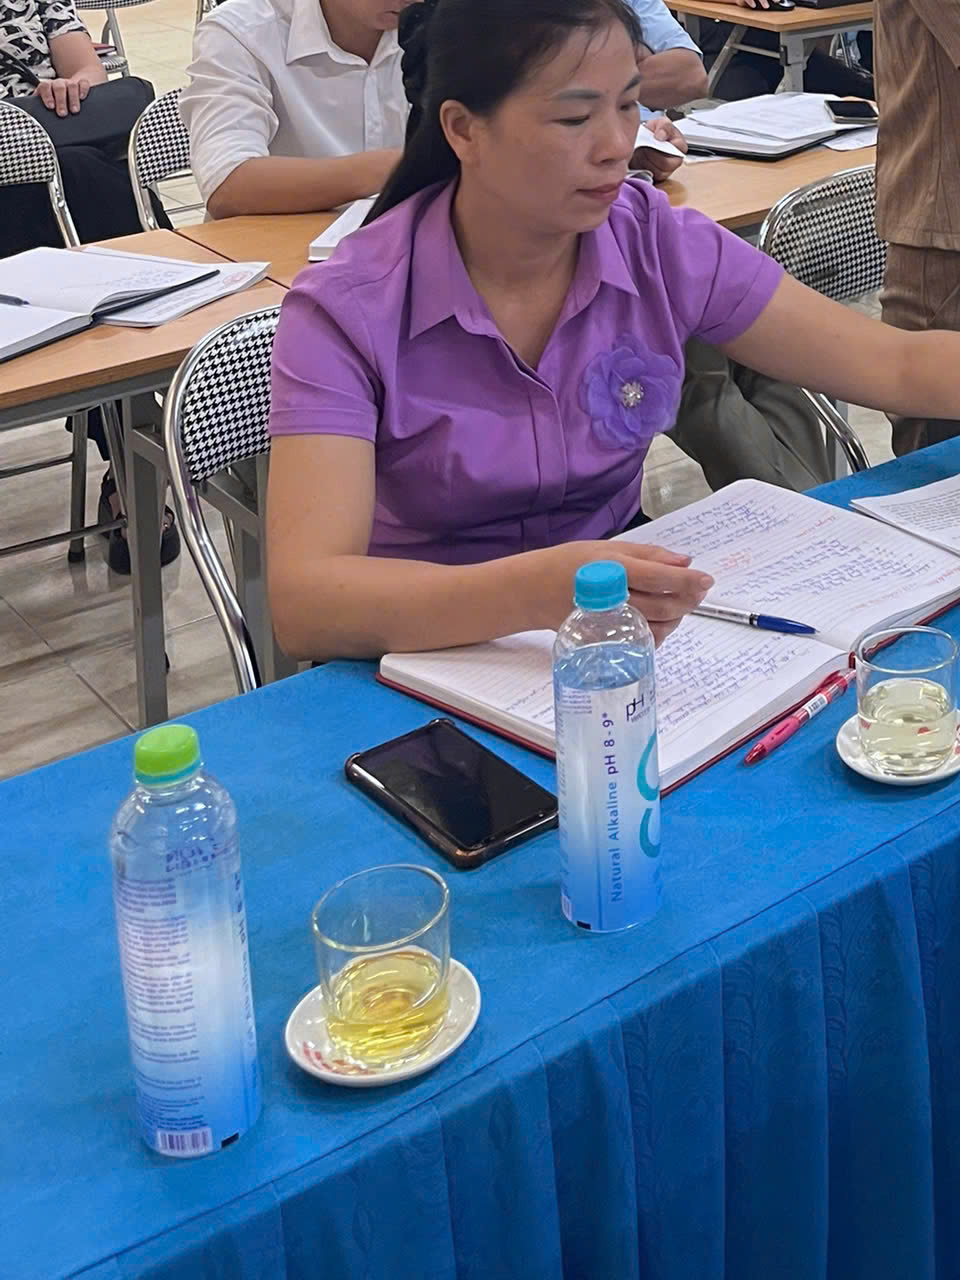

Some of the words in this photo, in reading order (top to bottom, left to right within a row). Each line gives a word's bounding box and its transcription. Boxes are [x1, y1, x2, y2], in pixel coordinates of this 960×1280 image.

[603, 754, 619, 775] pH
[607, 781, 620, 841] Alkaline
[608, 847, 623, 902] Natural
